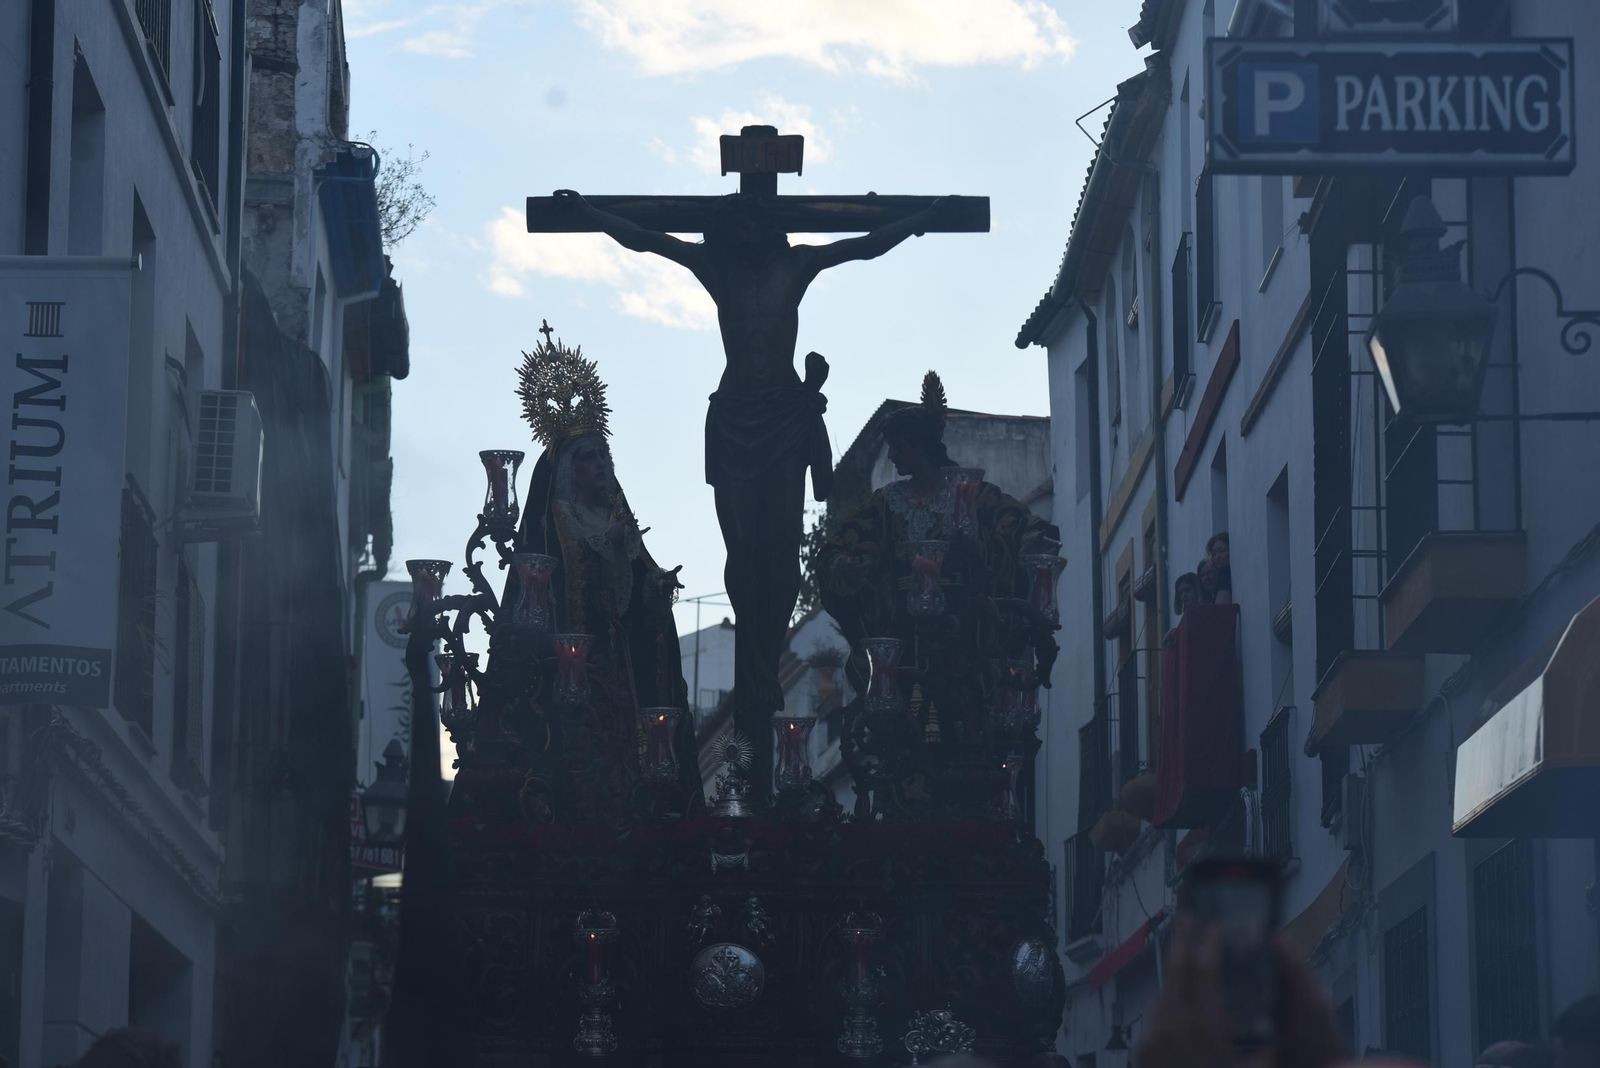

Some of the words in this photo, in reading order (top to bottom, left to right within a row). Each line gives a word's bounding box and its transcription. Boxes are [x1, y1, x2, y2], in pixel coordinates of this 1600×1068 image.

[1254, 70, 1305, 136] P
[1335, 74, 1550, 133] PARKING
[2, 352, 69, 631] ATRIUM
[0, 656, 102, 677] TAMENTOS
[0, 681, 67, 694] artments
